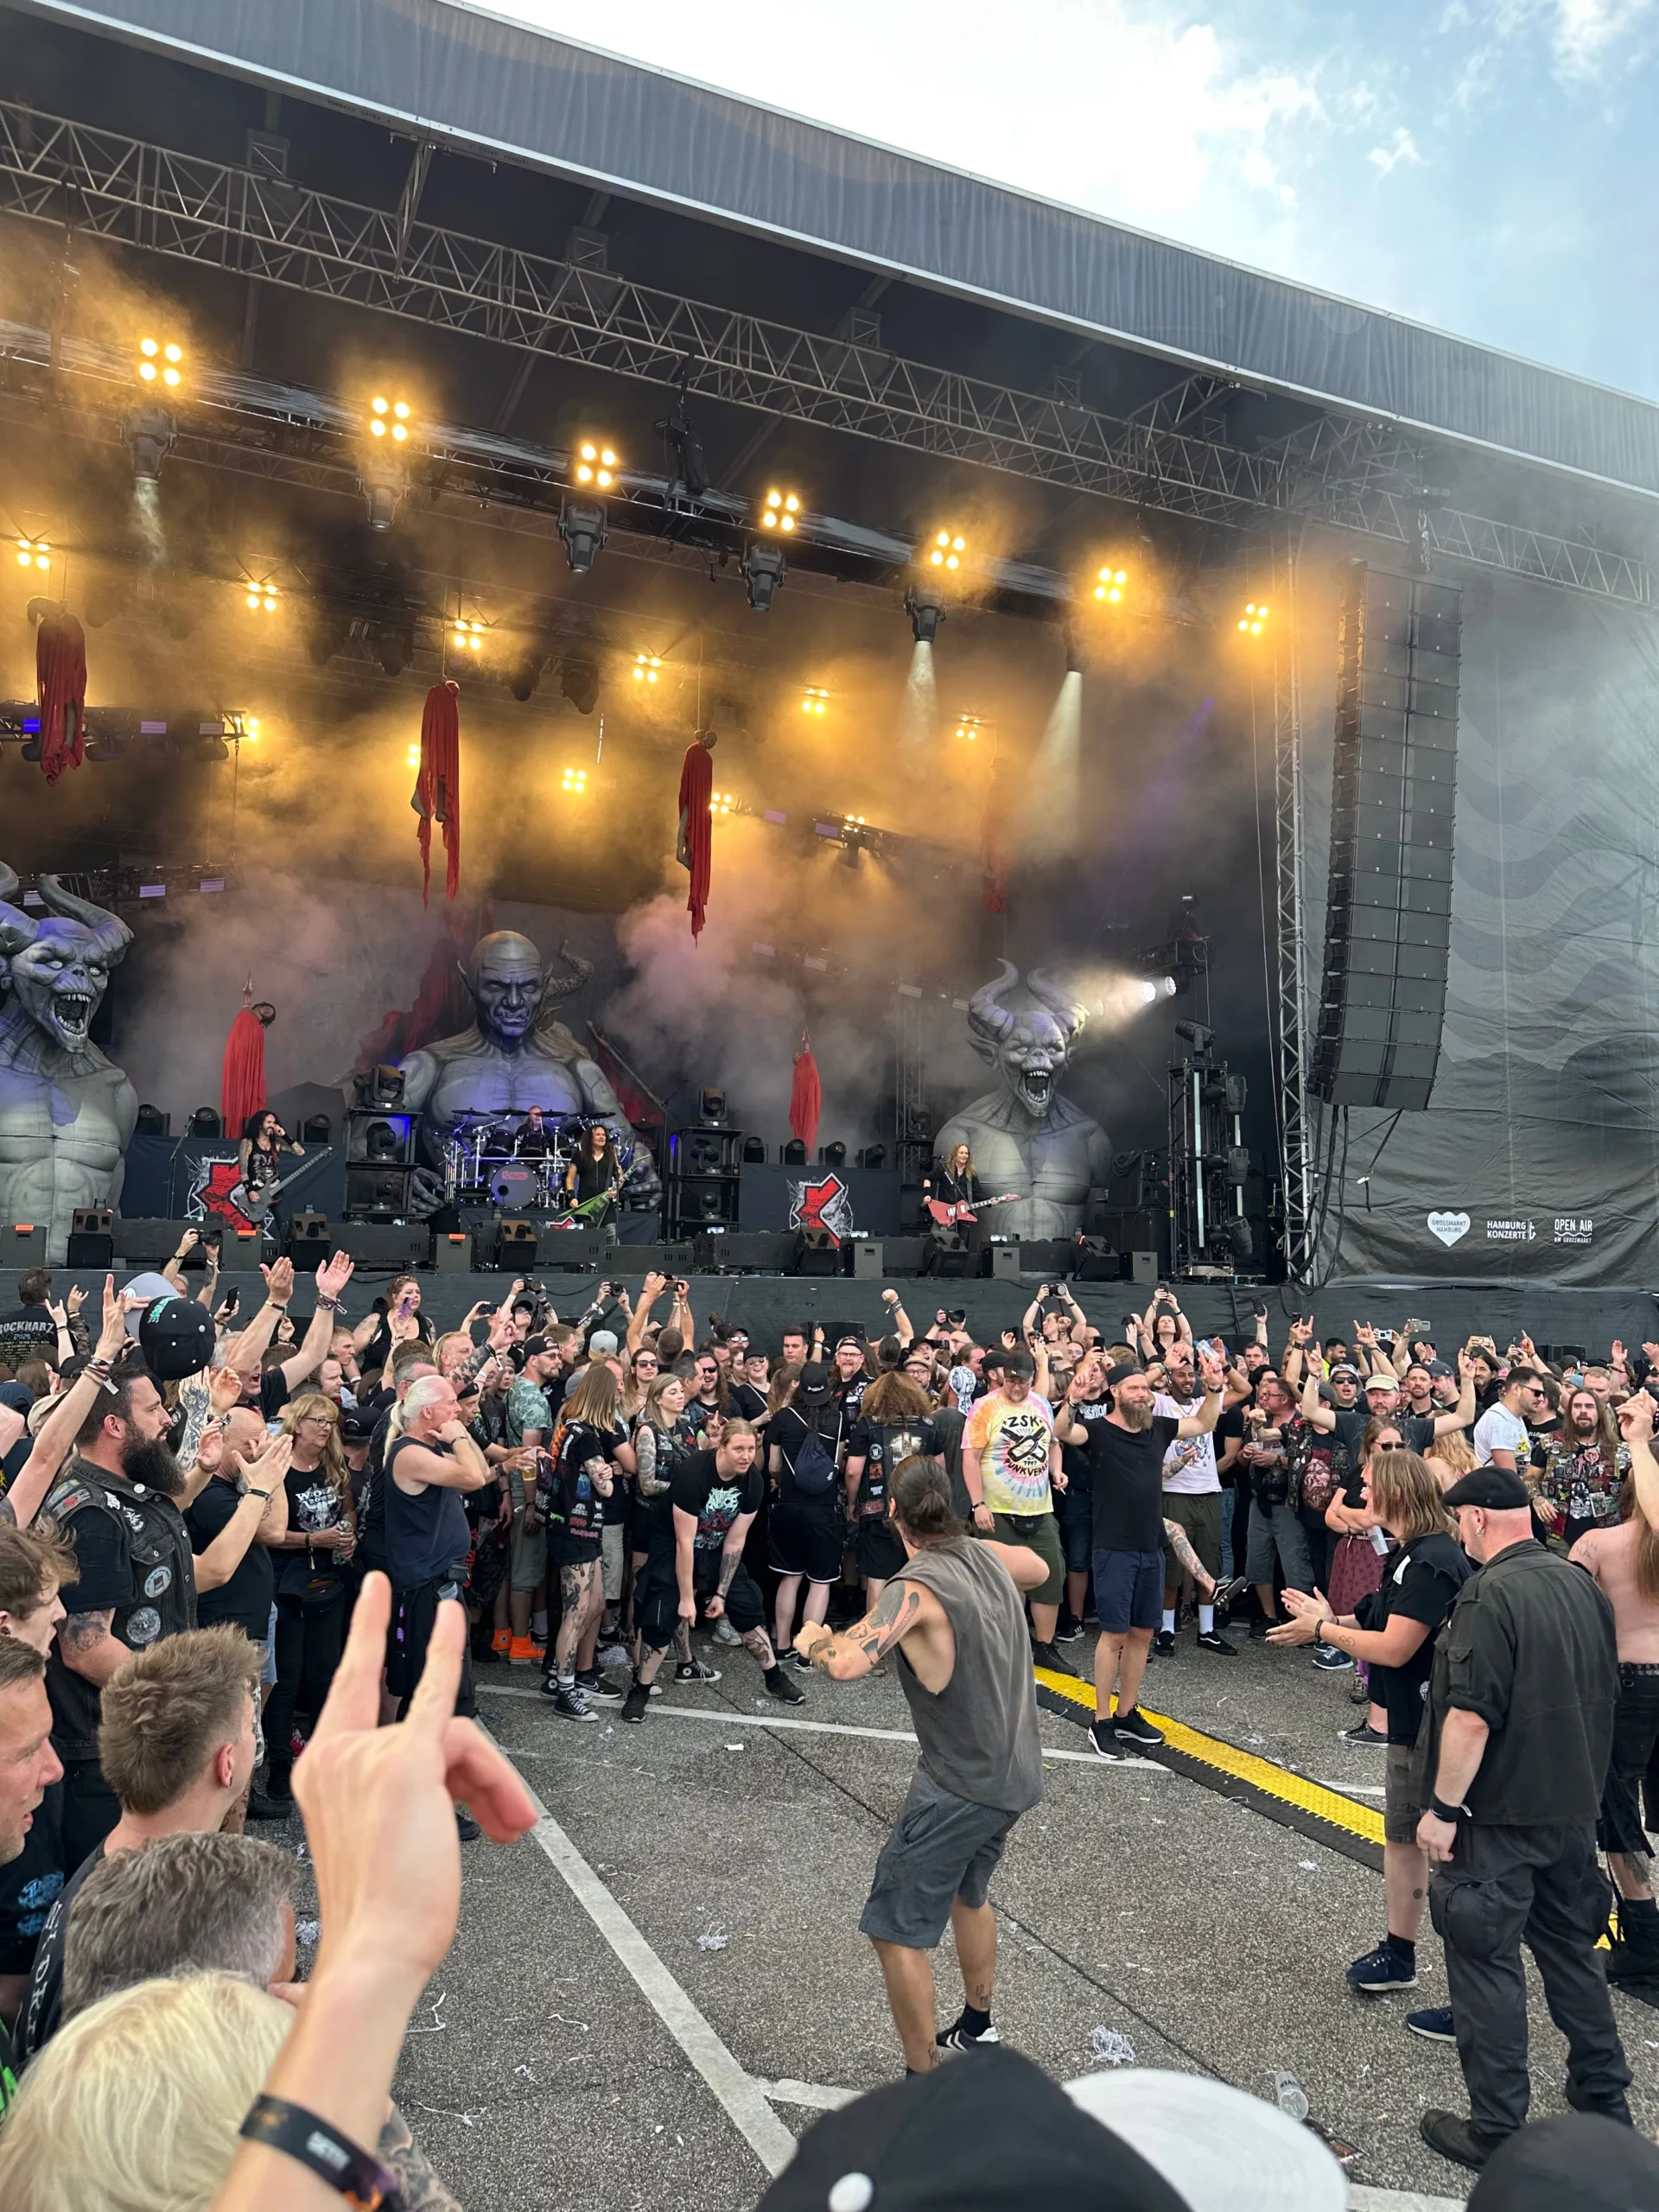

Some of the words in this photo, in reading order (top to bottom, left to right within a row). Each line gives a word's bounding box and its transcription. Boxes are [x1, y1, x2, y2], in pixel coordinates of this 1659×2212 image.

[1486, 1220, 1527, 1230] HAMBURG
[1554, 1218, 1576, 1231] OPEN
[1579, 1219, 1593, 1232] AIR
[1486, 1230, 1527, 1240] KONZERTE
[1007, 1415, 1039, 1427] ZSK
[1003, 1458, 1048, 1477] PUNKVERRA
